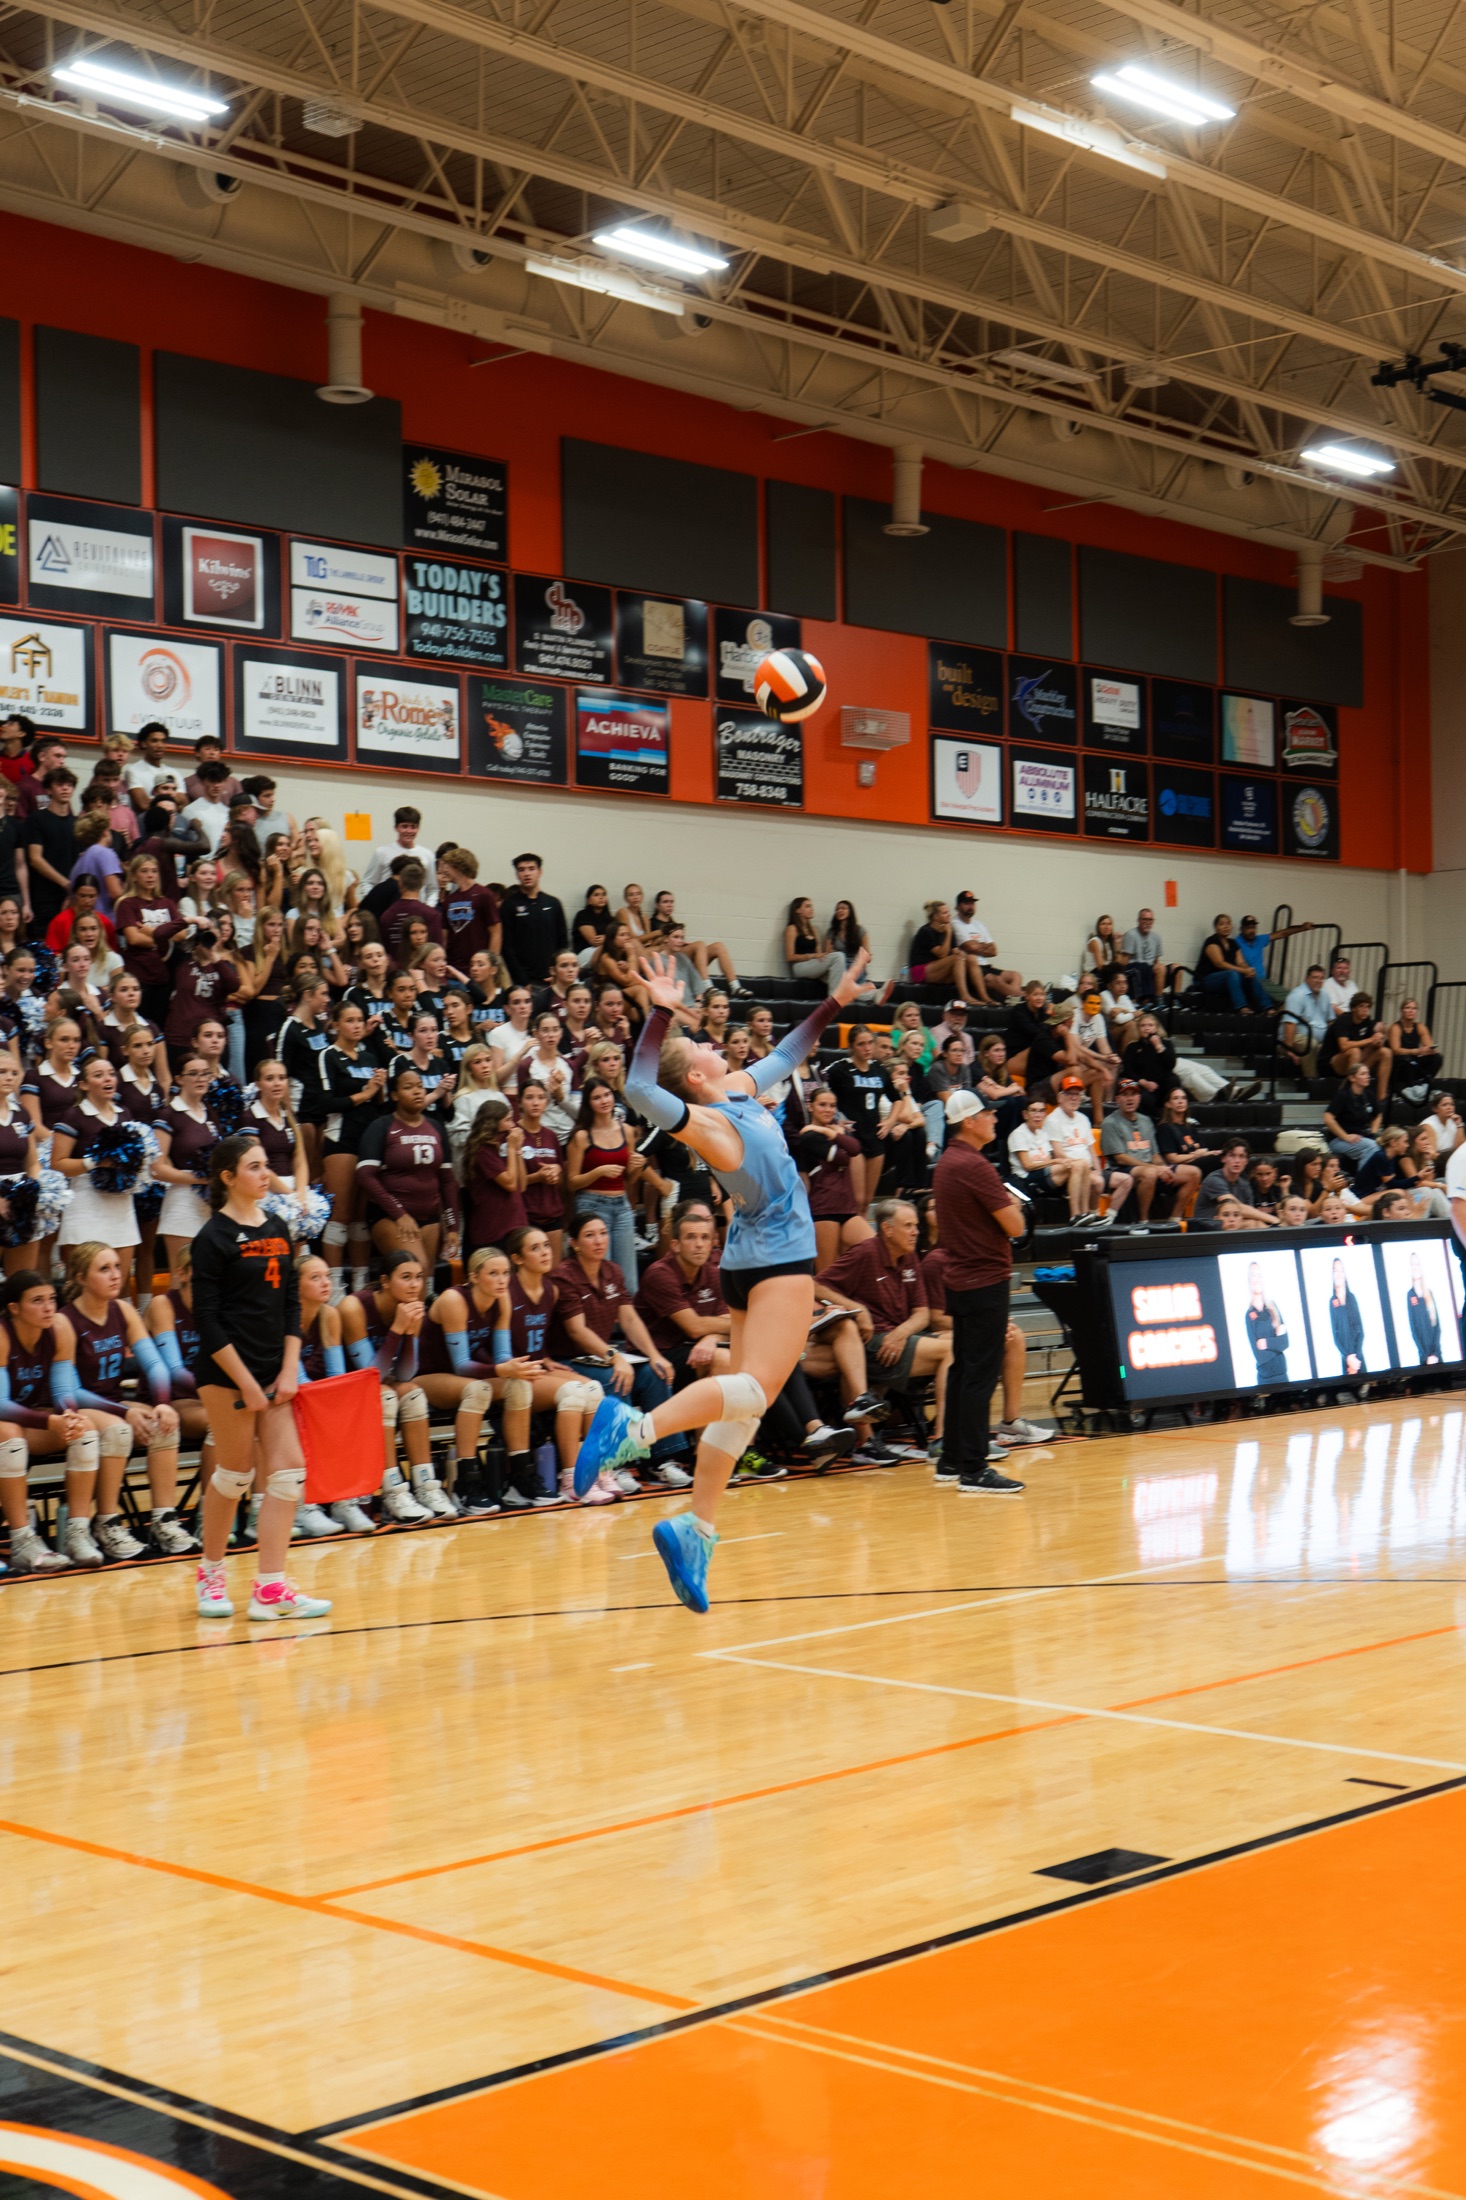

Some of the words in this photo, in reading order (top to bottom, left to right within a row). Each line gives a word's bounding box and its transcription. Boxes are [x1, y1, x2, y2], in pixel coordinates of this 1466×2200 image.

[445, 483, 489, 506] SOLAR
[413, 562, 501, 599] TODAY'S
[407, 589, 507, 628] BUILDERS
[412, 639, 504, 663] TodaysBuilders.com
[937, 660, 973, 684] built
[274, 675, 323, 699] BLINN
[381, 691, 437, 728] Rome
[952, 685, 999, 715] design
[585, 717, 662, 741] ACHIEVA
[608, 762, 649, 775] BANKING
[736, 749, 786, 764] MASONRY
[1019, 765, 1069, 780] ABSOLUTE
[1019, 776, 1070, 791] ALUMINUM
[1085, 791, 1149, 814] HALFACRE
[412, 1144, 435, 1165] 13
[264, 1257, 281, 1289] 4
[92, 1335, 123, 1354] RAMS
[526, 1328, 545, 1353] 15
[98, 1352, 122, 1381] 12
